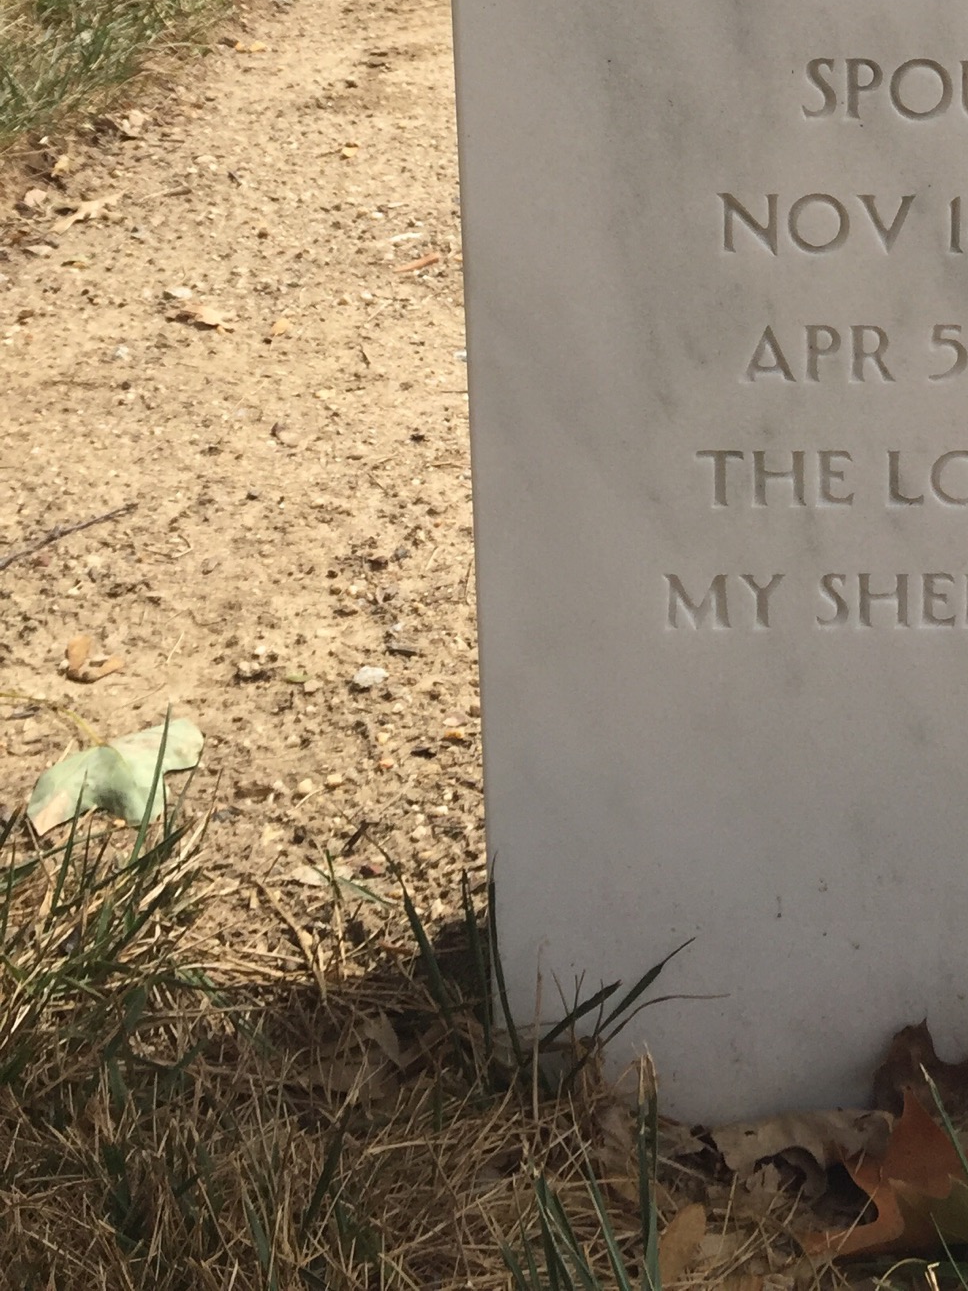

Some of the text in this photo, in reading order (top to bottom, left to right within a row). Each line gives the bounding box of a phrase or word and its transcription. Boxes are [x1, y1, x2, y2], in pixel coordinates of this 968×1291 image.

[717, 192, 916, 256] NOV
[742, 323, 896, 384] APR
[695, 449, 856, 508] THE
[662, 572, 786, 631] MY
